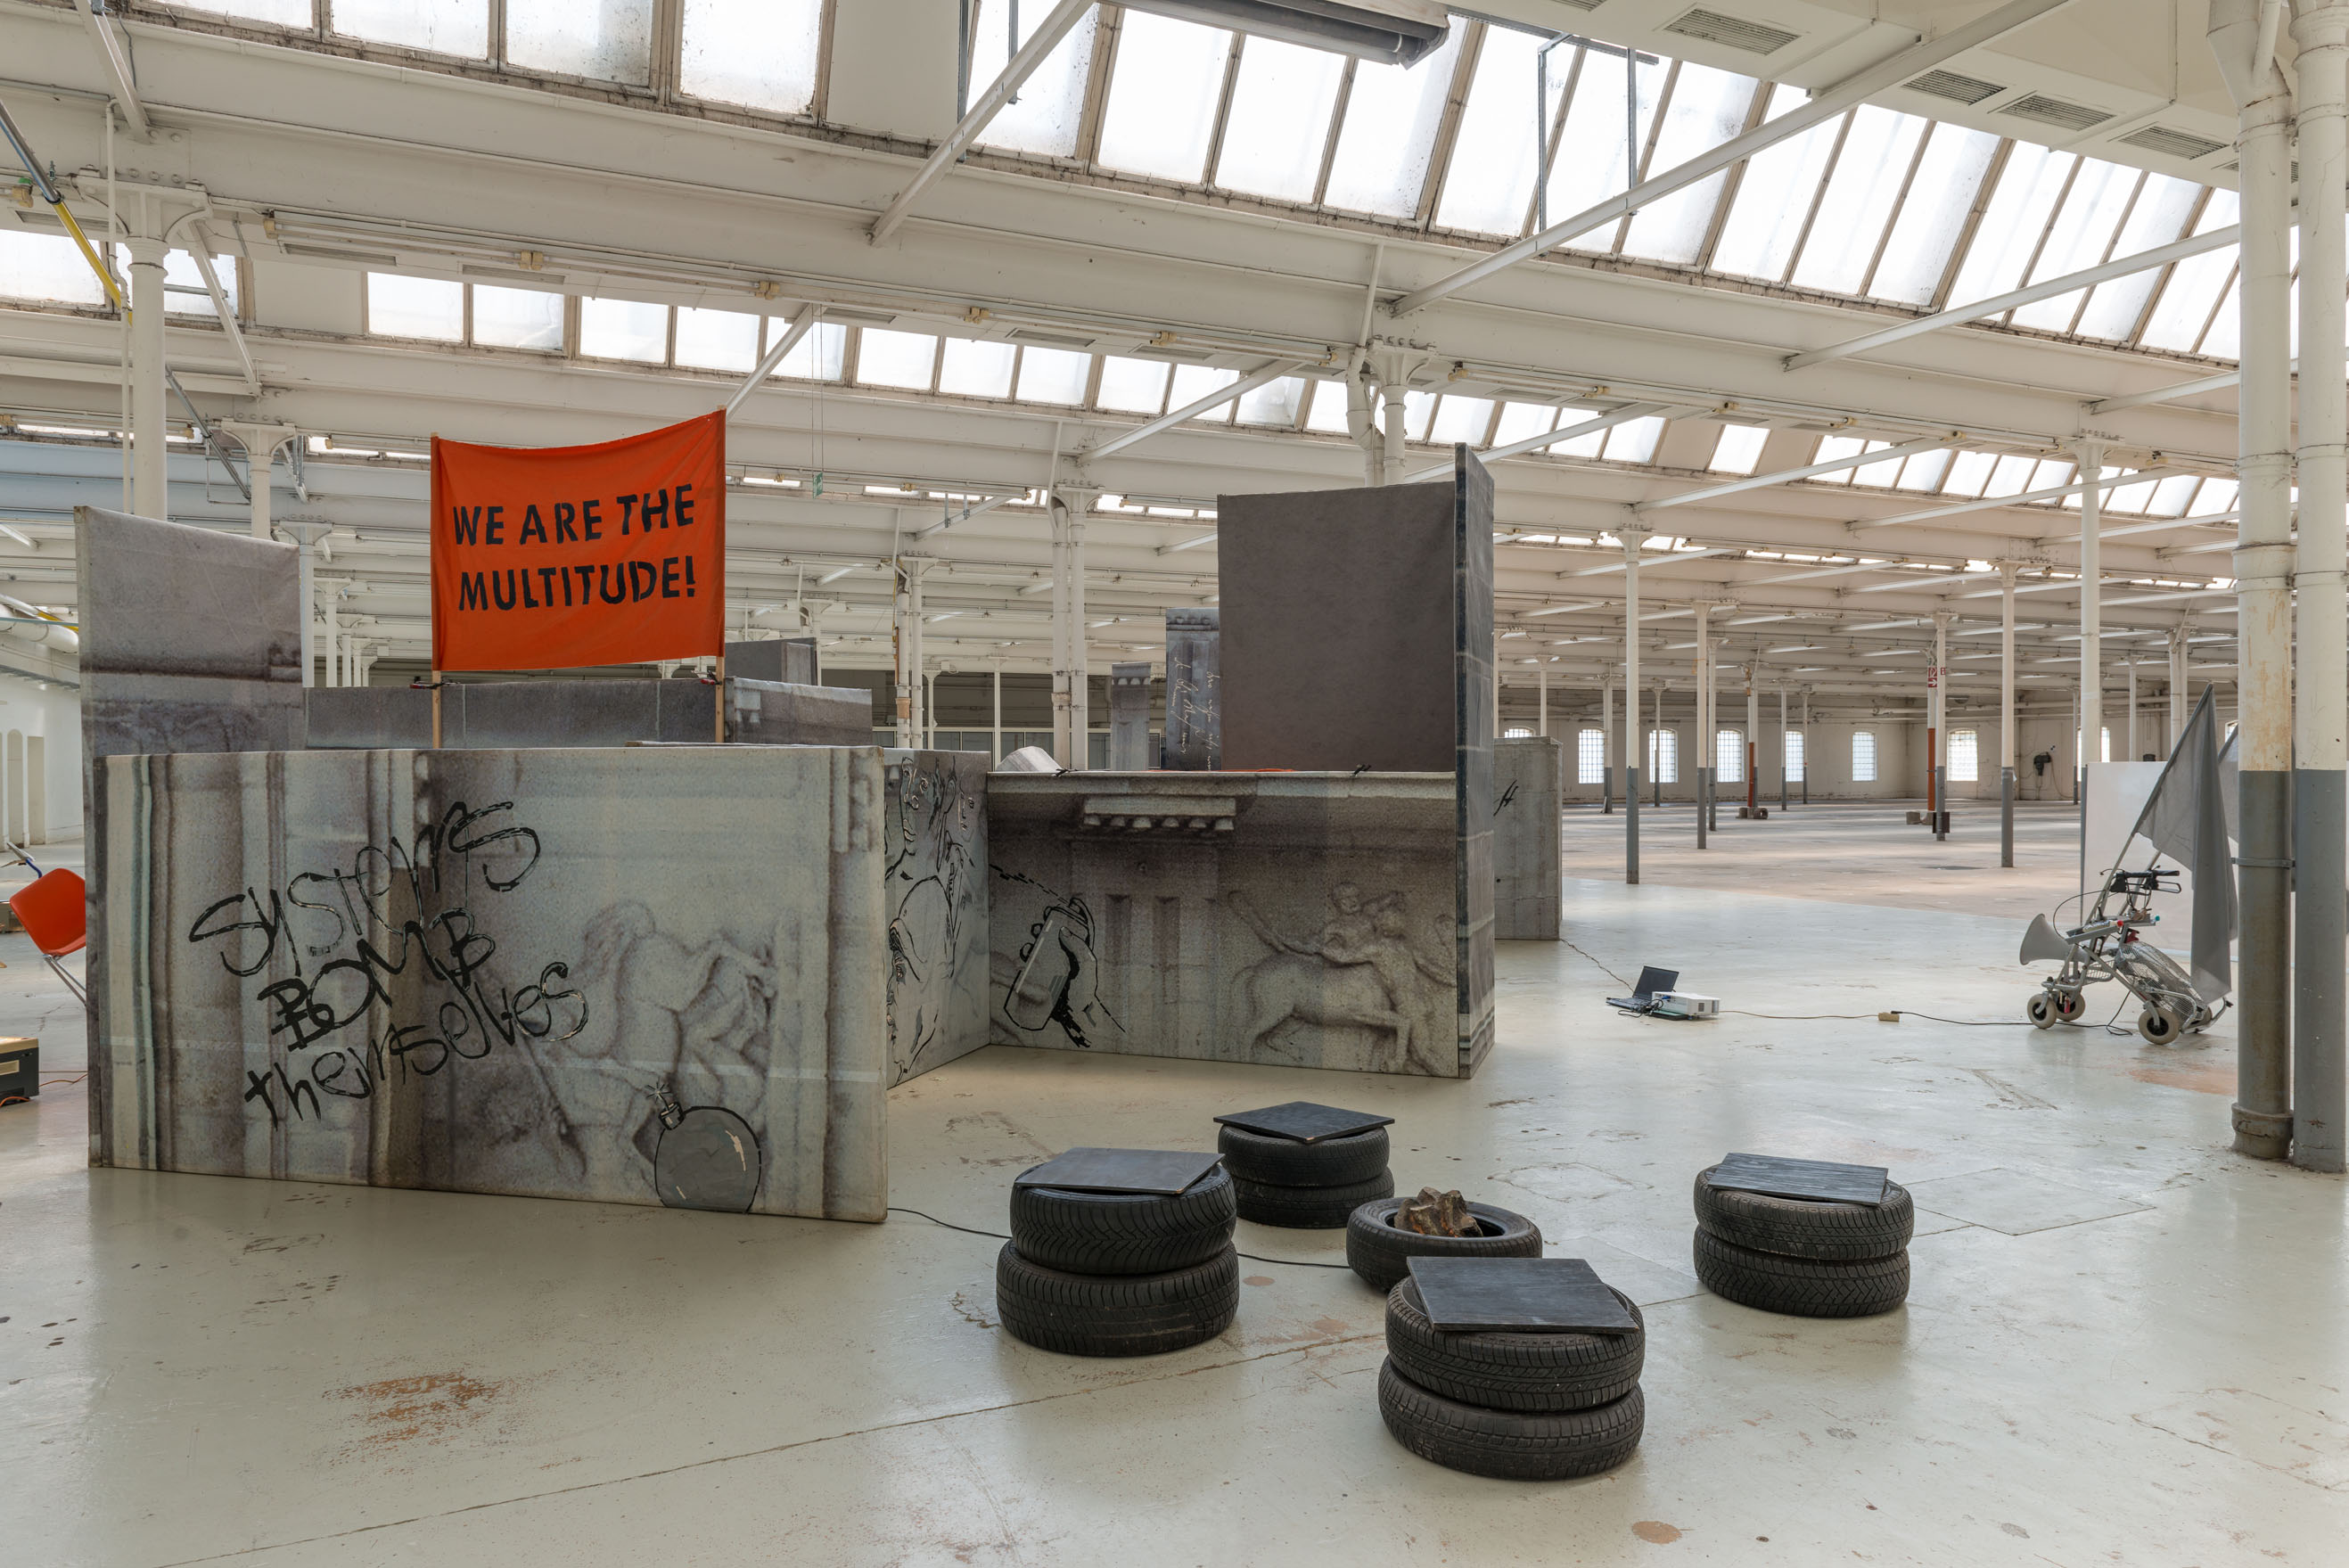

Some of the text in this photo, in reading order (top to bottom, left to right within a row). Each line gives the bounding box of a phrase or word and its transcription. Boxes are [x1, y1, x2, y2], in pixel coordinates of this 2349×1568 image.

[453, 483, 694, 546] WE ARE THE
[458, 555, 696, 611] MULTITUDE!
